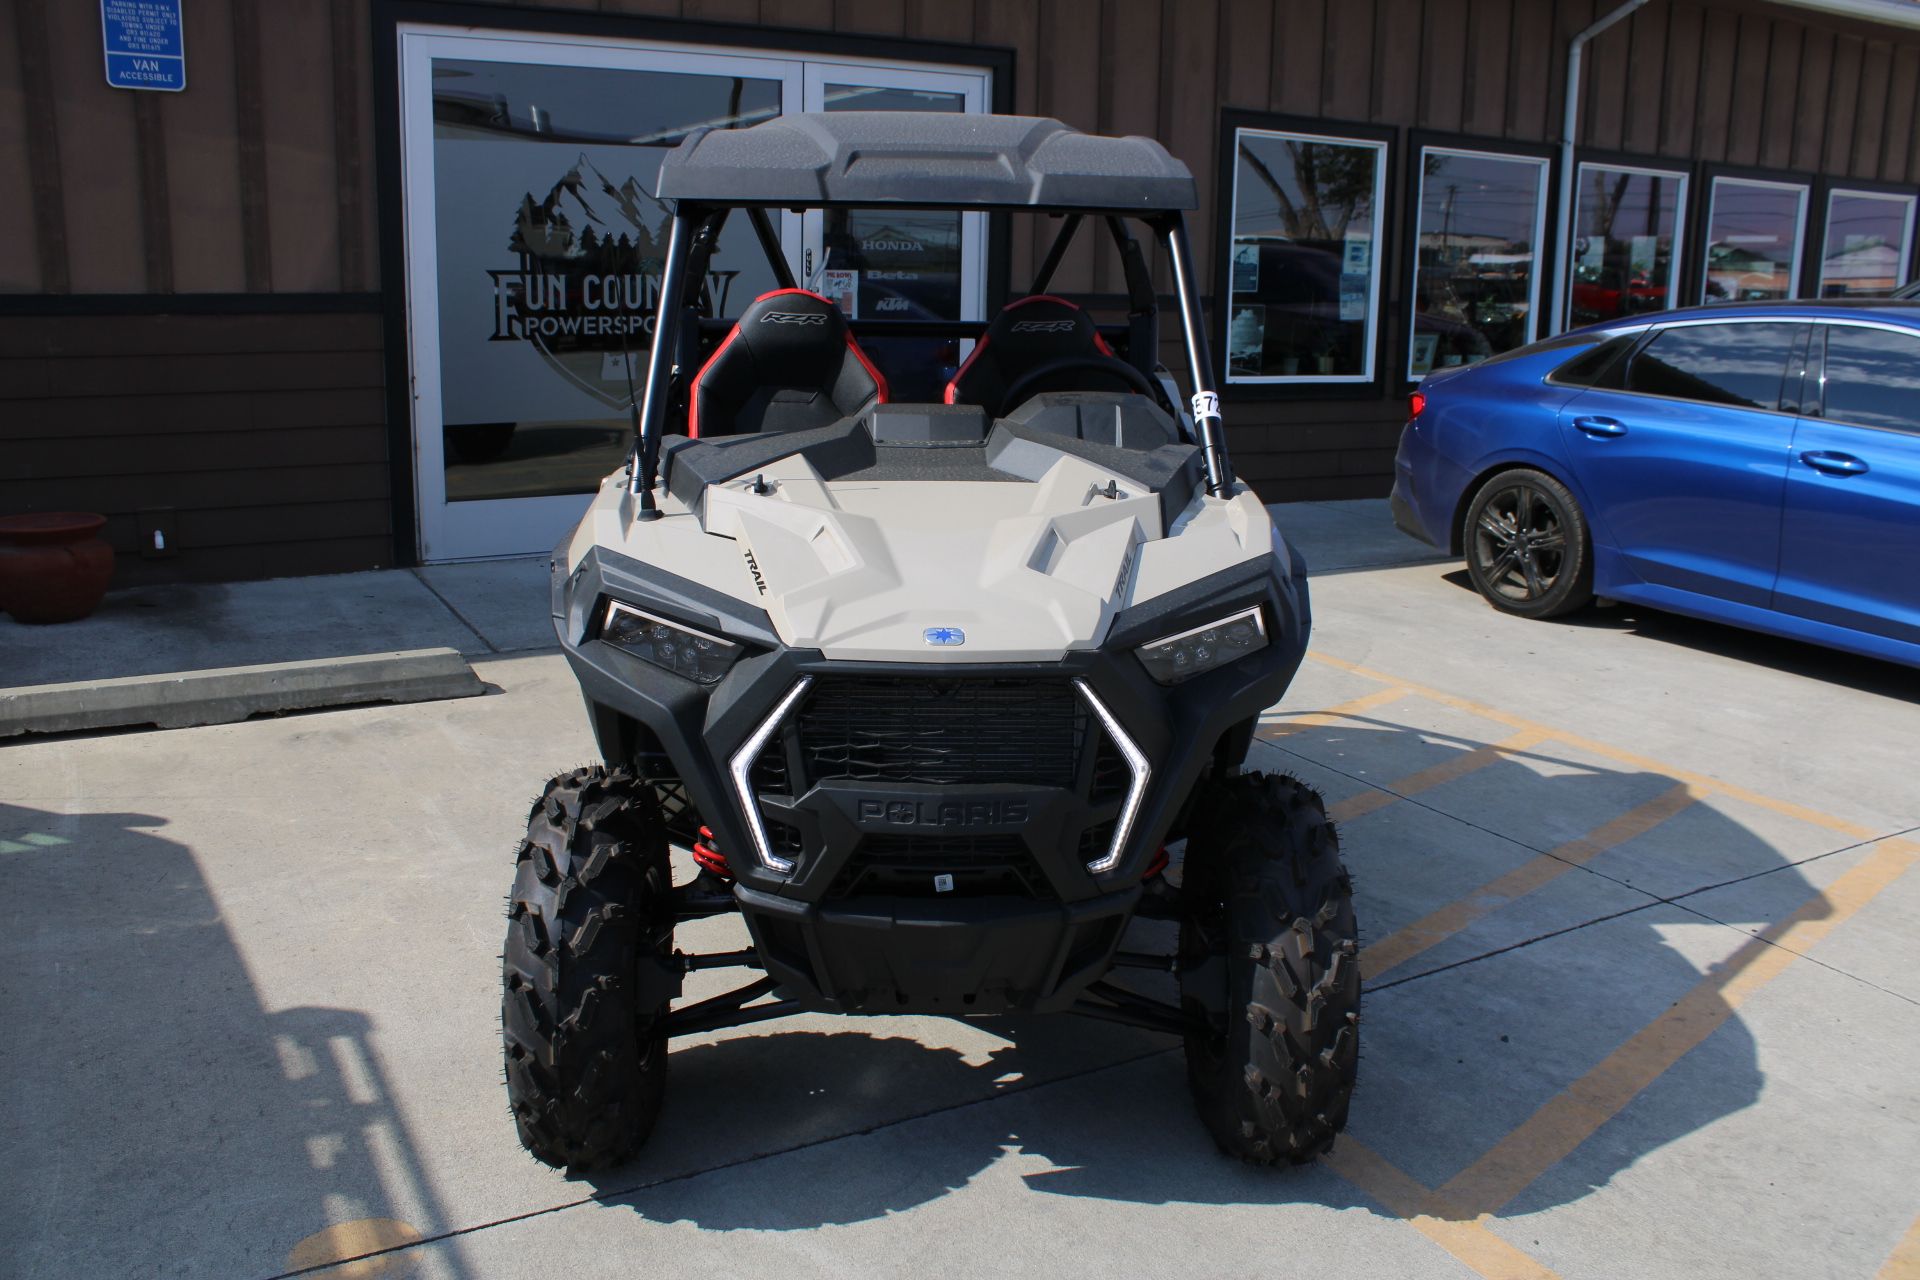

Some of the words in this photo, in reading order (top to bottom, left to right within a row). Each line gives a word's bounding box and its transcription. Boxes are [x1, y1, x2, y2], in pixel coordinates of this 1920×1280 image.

[132, 59, 159, 72] VAN
[119, 71, 173, 83] ACCESSIBLE
[861, 239, 924, 252] HONDA
[867, 269, 918, 280] Beta
[489, 271, 568, 339] FUN
[582, 272, 731, 320] COUNY
[875, 297, 910, 311] KTM
[760, 311, 828, 326] RZR
[1010, 319, 1076, 332] RZR
[525, 315, 657, 337] POWERSPO
[743, 548, 769, 597] TRAIL
[1115, 552, 1132, 599] TRAIL
[857, 797, 1031, 827] POLARIS
